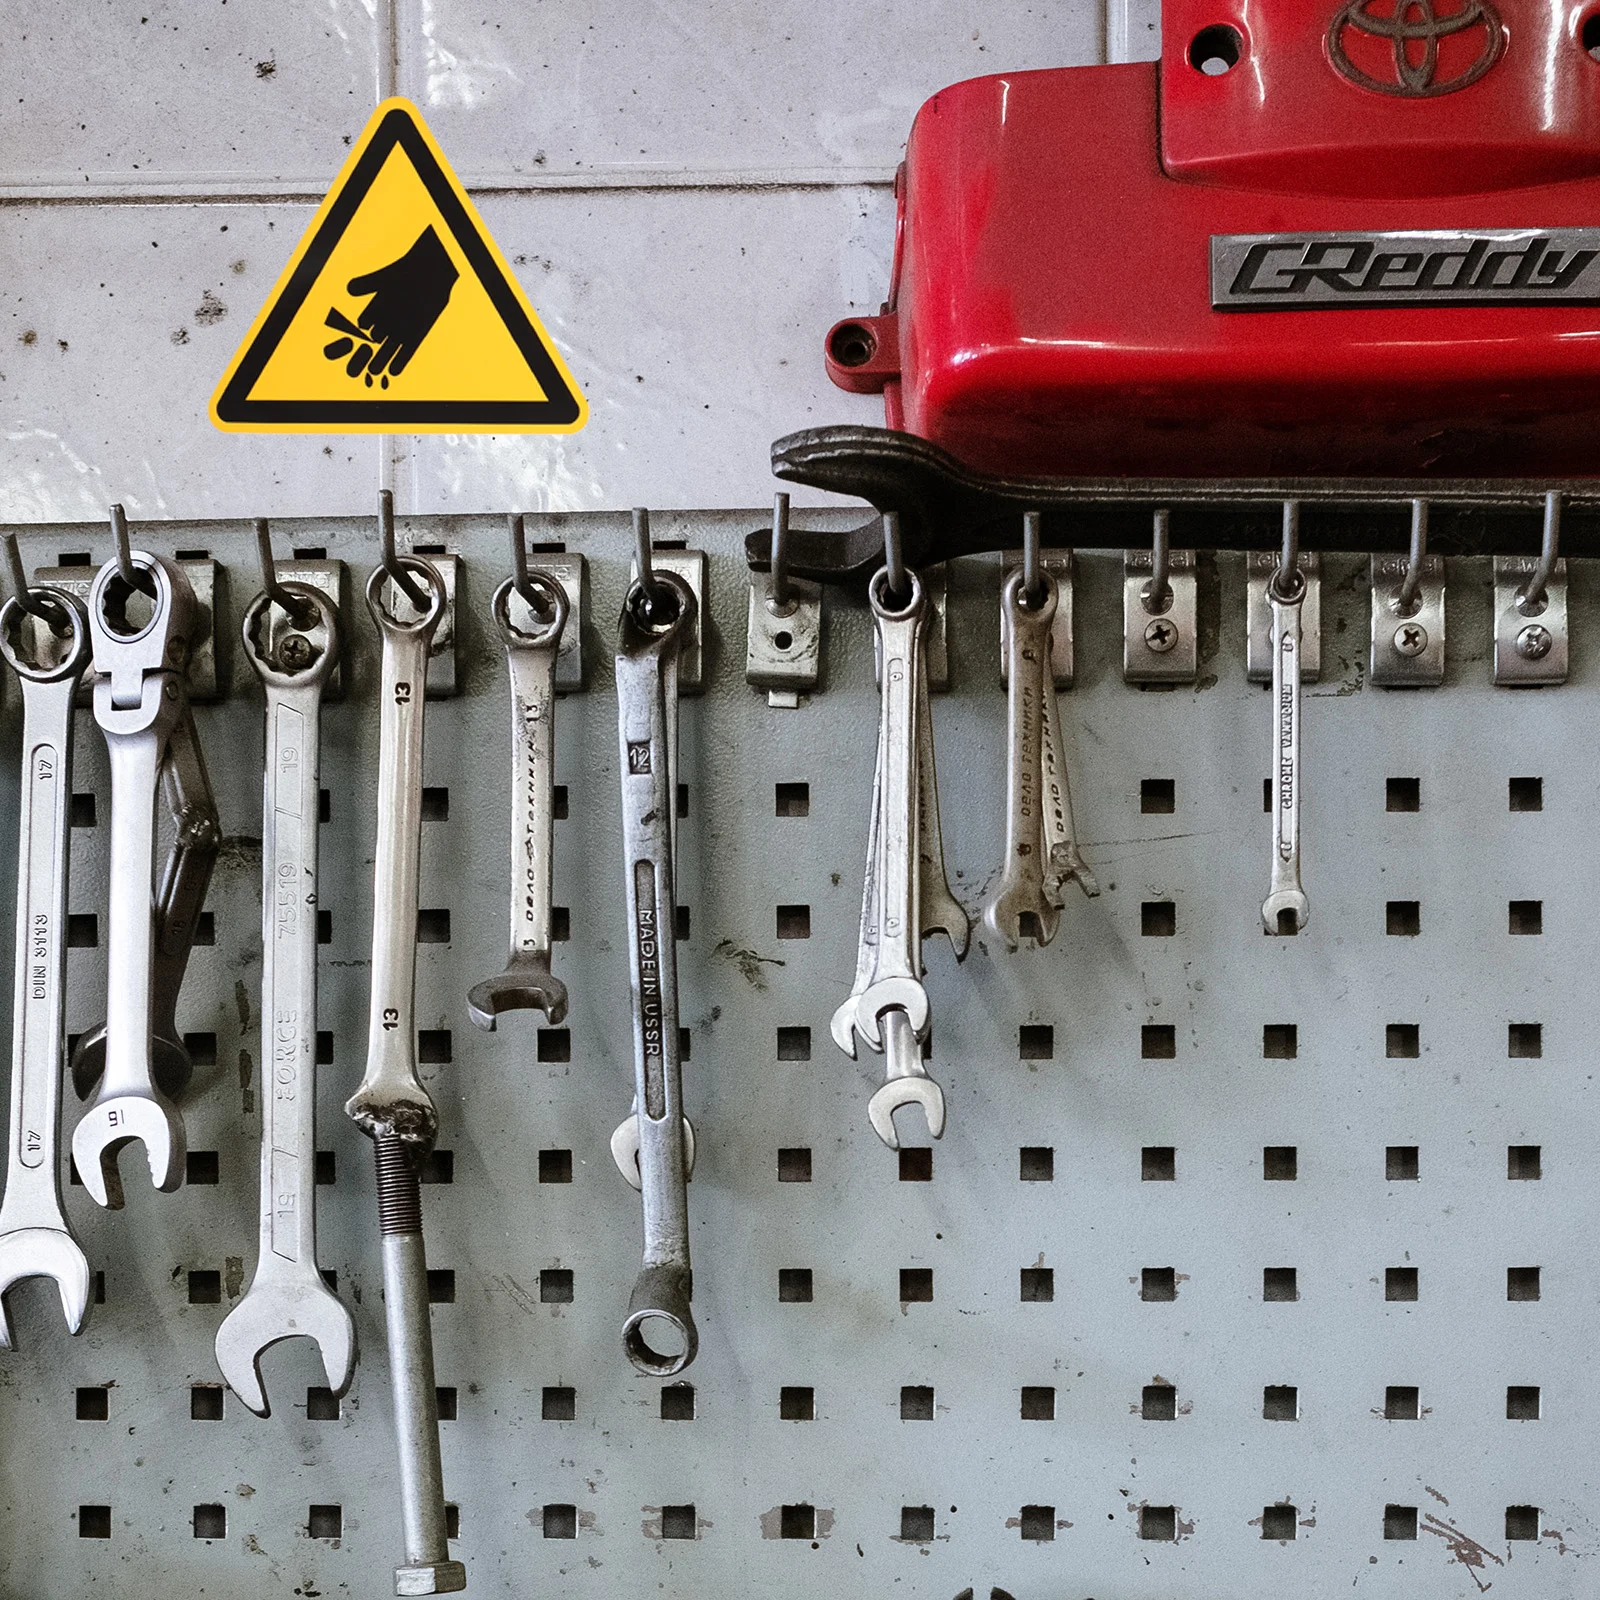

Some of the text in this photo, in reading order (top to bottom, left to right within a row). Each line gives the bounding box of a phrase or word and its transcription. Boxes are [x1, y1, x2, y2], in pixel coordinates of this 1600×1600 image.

[395, 682, 411, 705] 13
[279, 747, 298, 774] 19
[629, 747, 649, 767] 12
[1281, 684, 1294, 810] CHROME VANADIUM
[38, 758, 53, 780] 17
[278, 862, 297, 940] 75519
[33, 914, 48, 1000] DIN 3113
[639, 910, 660, 1056] MADE IN USSR
[382, 1008, 399, 1031] 13
[276, 1010, 297, 1101] FORCE
[27, 1130, 42, 1152] 17
